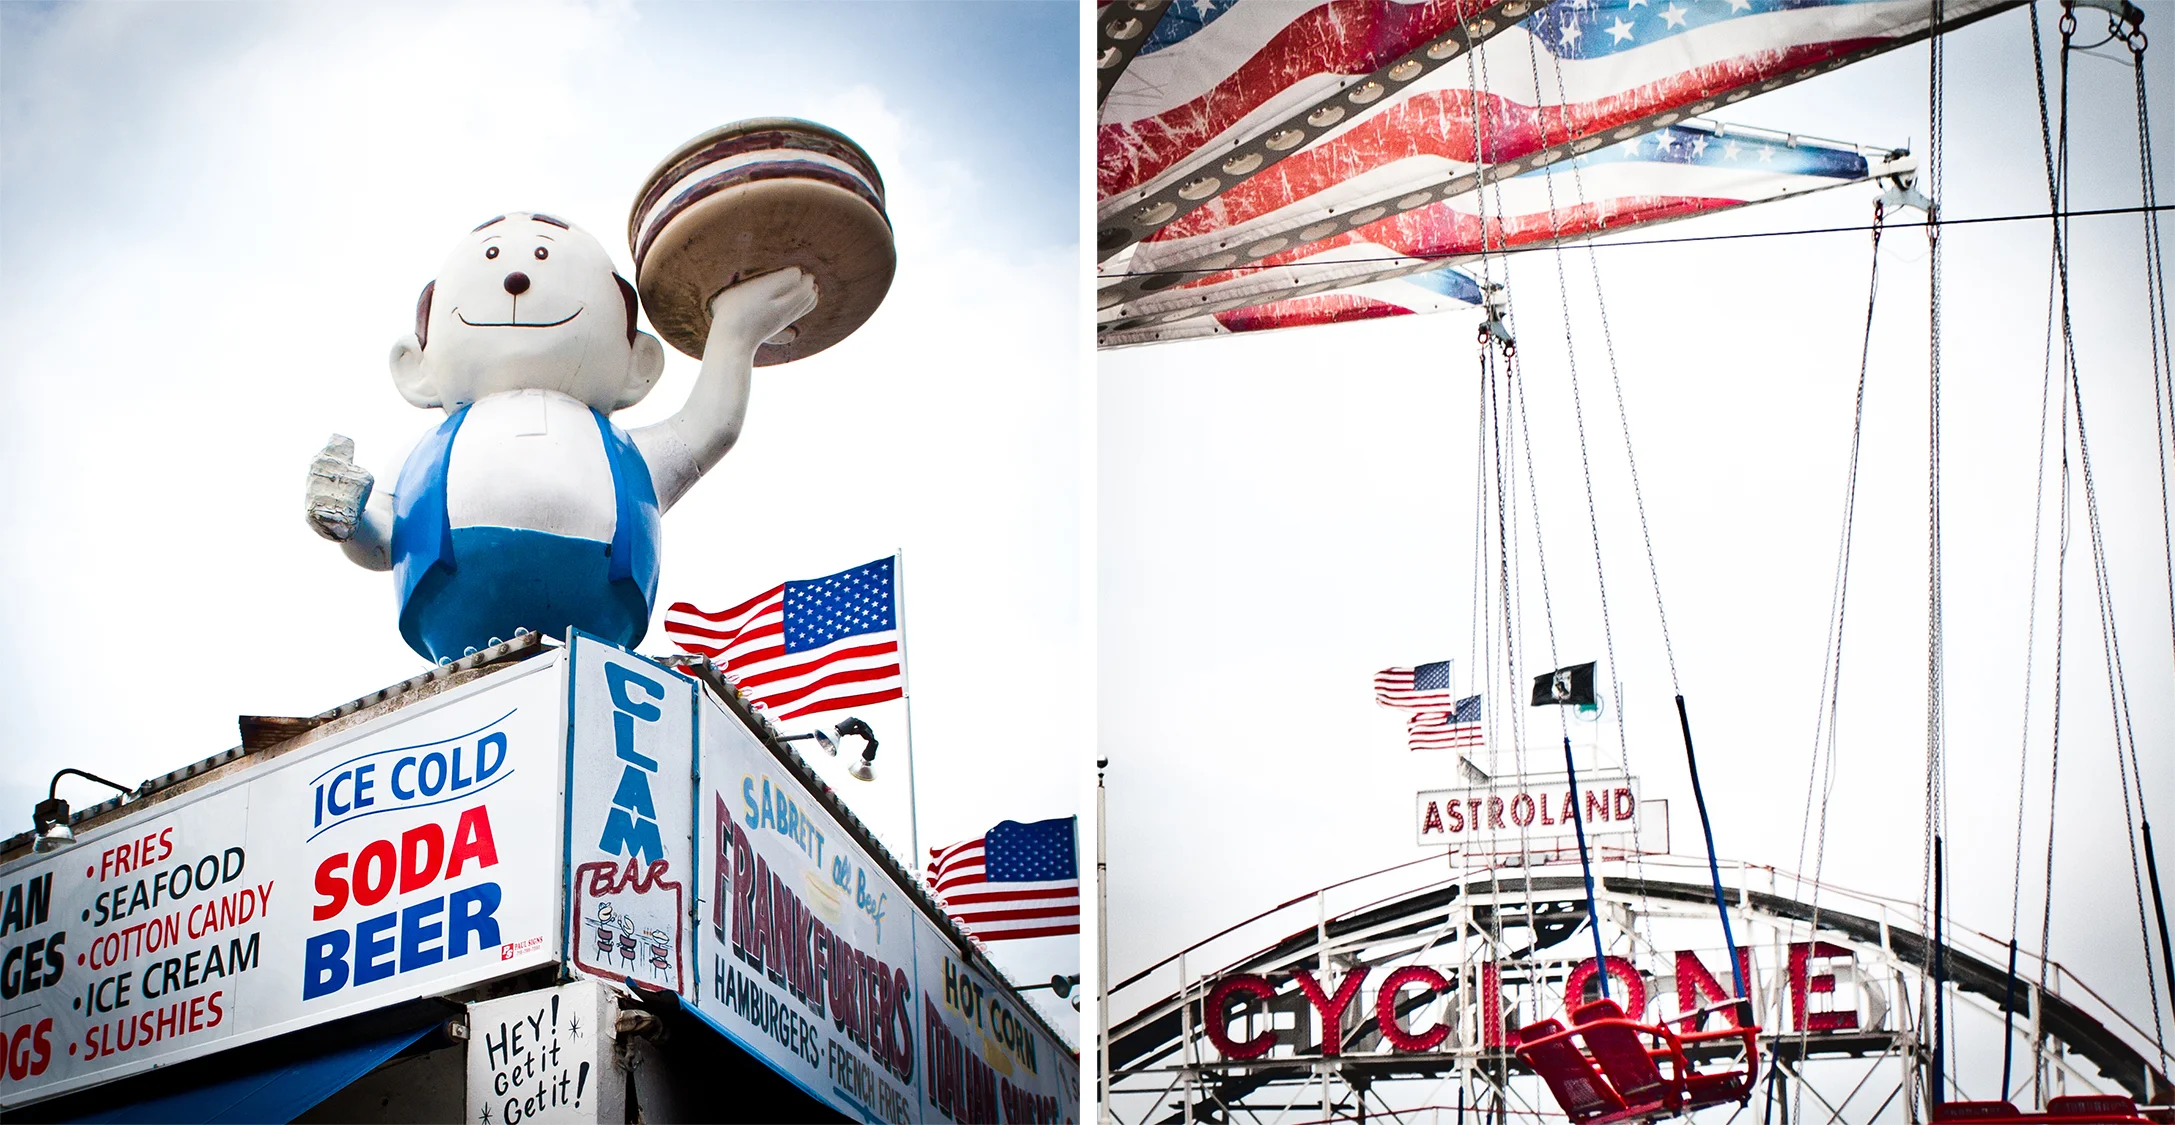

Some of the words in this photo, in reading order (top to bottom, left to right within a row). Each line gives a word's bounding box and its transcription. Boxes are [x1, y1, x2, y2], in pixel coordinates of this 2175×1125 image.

[314, 763, 375, 828] ICE
[391, 731, 507, 800] COLD
[599, 661, 665, 866] CLAM
[100, 826, 173, 882] FRIES
[1422, 787, 1635, 834] ASTROLAND
[94, 846, 245, 927] SEAFOOD
[313, 804, 499, 921] SODA
[590, 857, 669, 897] BAR
[741, 772, 825, 869] SABRETT
[855, 866, 888, 945] Beef
[0, 872, 53, 938] AN
[89, 912, 180, 970] COTTON
[188, 880, 274, 940] CANDY
[303, 882, 502, 1002] BEER
[713, 789, 915, 1087] FRANKFURTERS
[85, 971, 132, 1017] ICE
[142, 932, 260, 999] CREAM
[942, 956, 984, 1037] HOT
[988, 999, 1037, 1078] CORN
[1203, 942, 1860, 1060] CYCLONE
[84, 991, 223, 1061] SLUSHIES
[486, 994, 559, 1071] HEY!
[542, 1038, 561, 1072] it
[714, 953, 820, 1070] HAMBURGERS
[828, 1037, 875, 1110] FRENCH
[878, 1076, 911, 1125] FRIES
[504, 1080, 547, 1125] Get
[552, 1061, 590, 1109] it!
